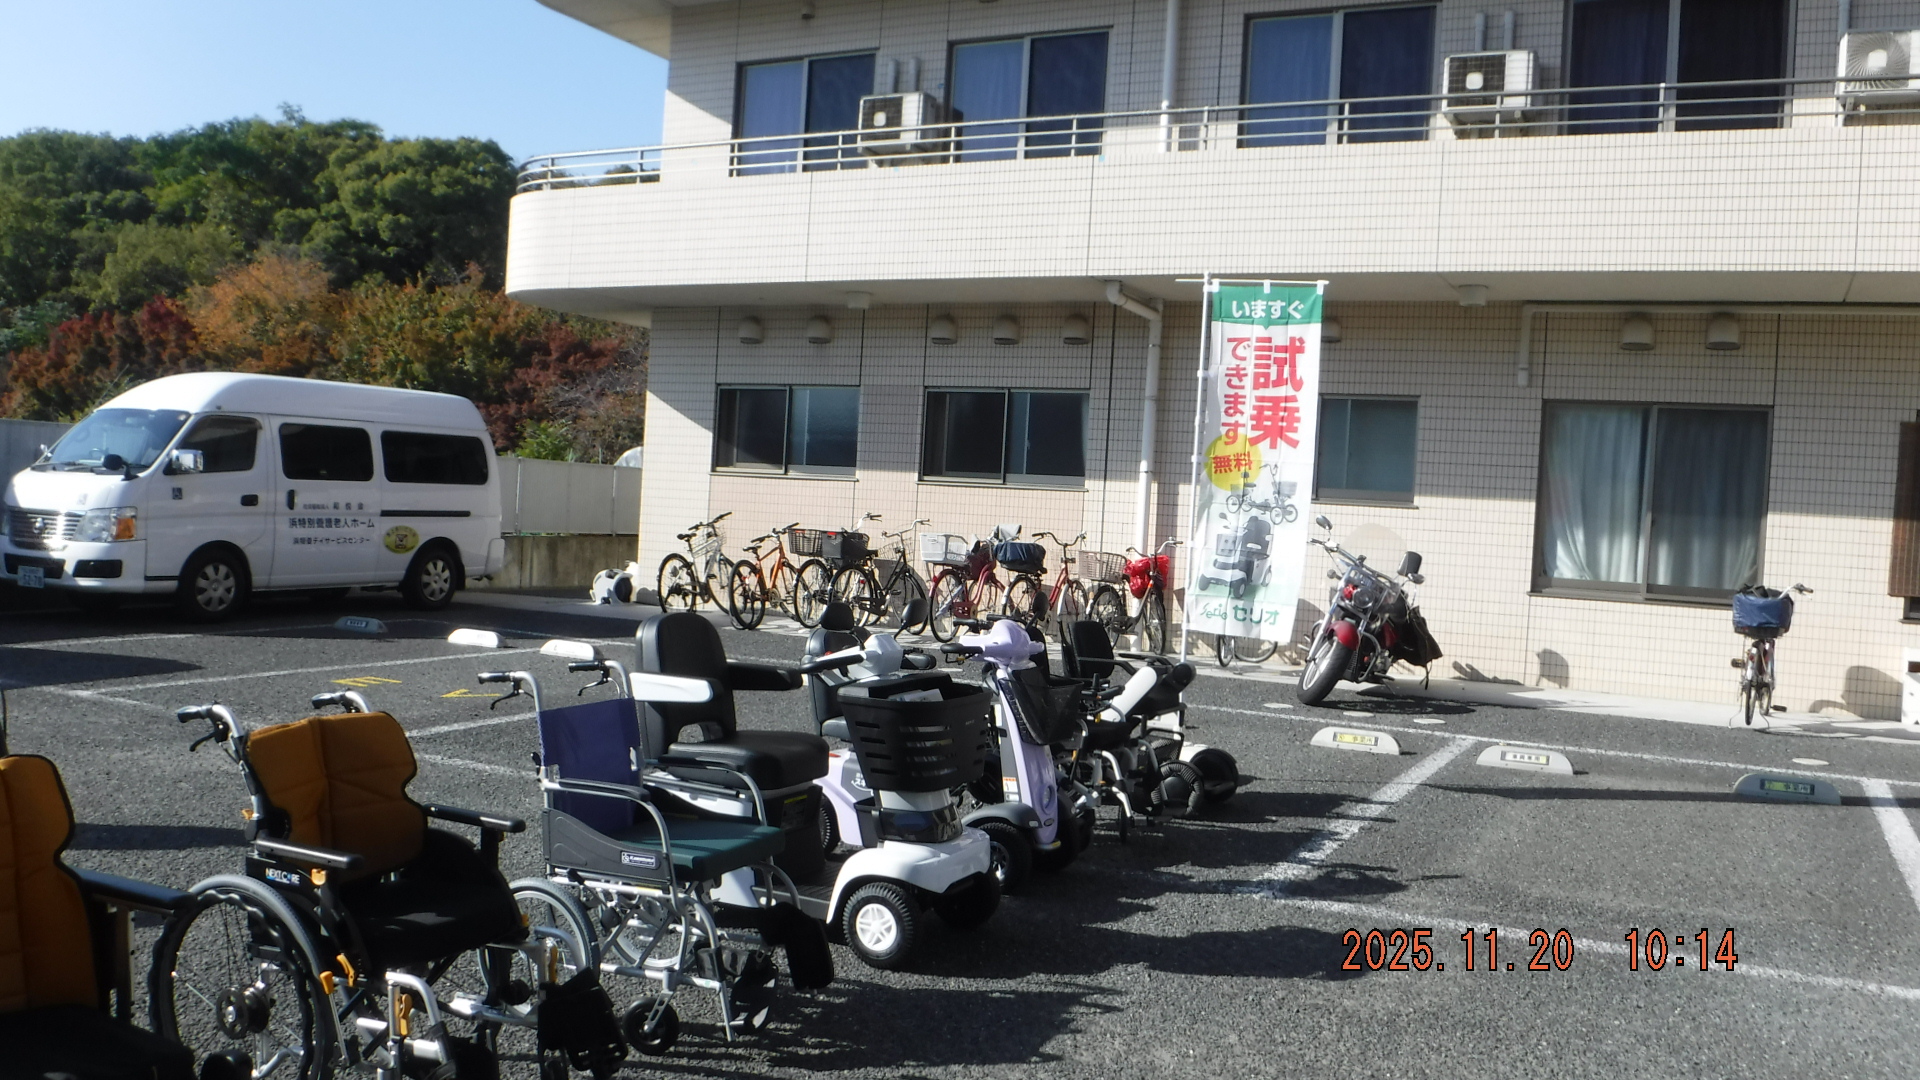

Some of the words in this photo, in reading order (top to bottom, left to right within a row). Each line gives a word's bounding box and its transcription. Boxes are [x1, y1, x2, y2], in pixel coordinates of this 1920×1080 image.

[1232, 299, 1305, 320] いますぐ
[1221, 337, 1251, 446] できます
[1248, 336, 1306, 450] 試乗
[1212, 451, 1252, 474] 無料
[1233, 604, 1280, 625] セリオ
